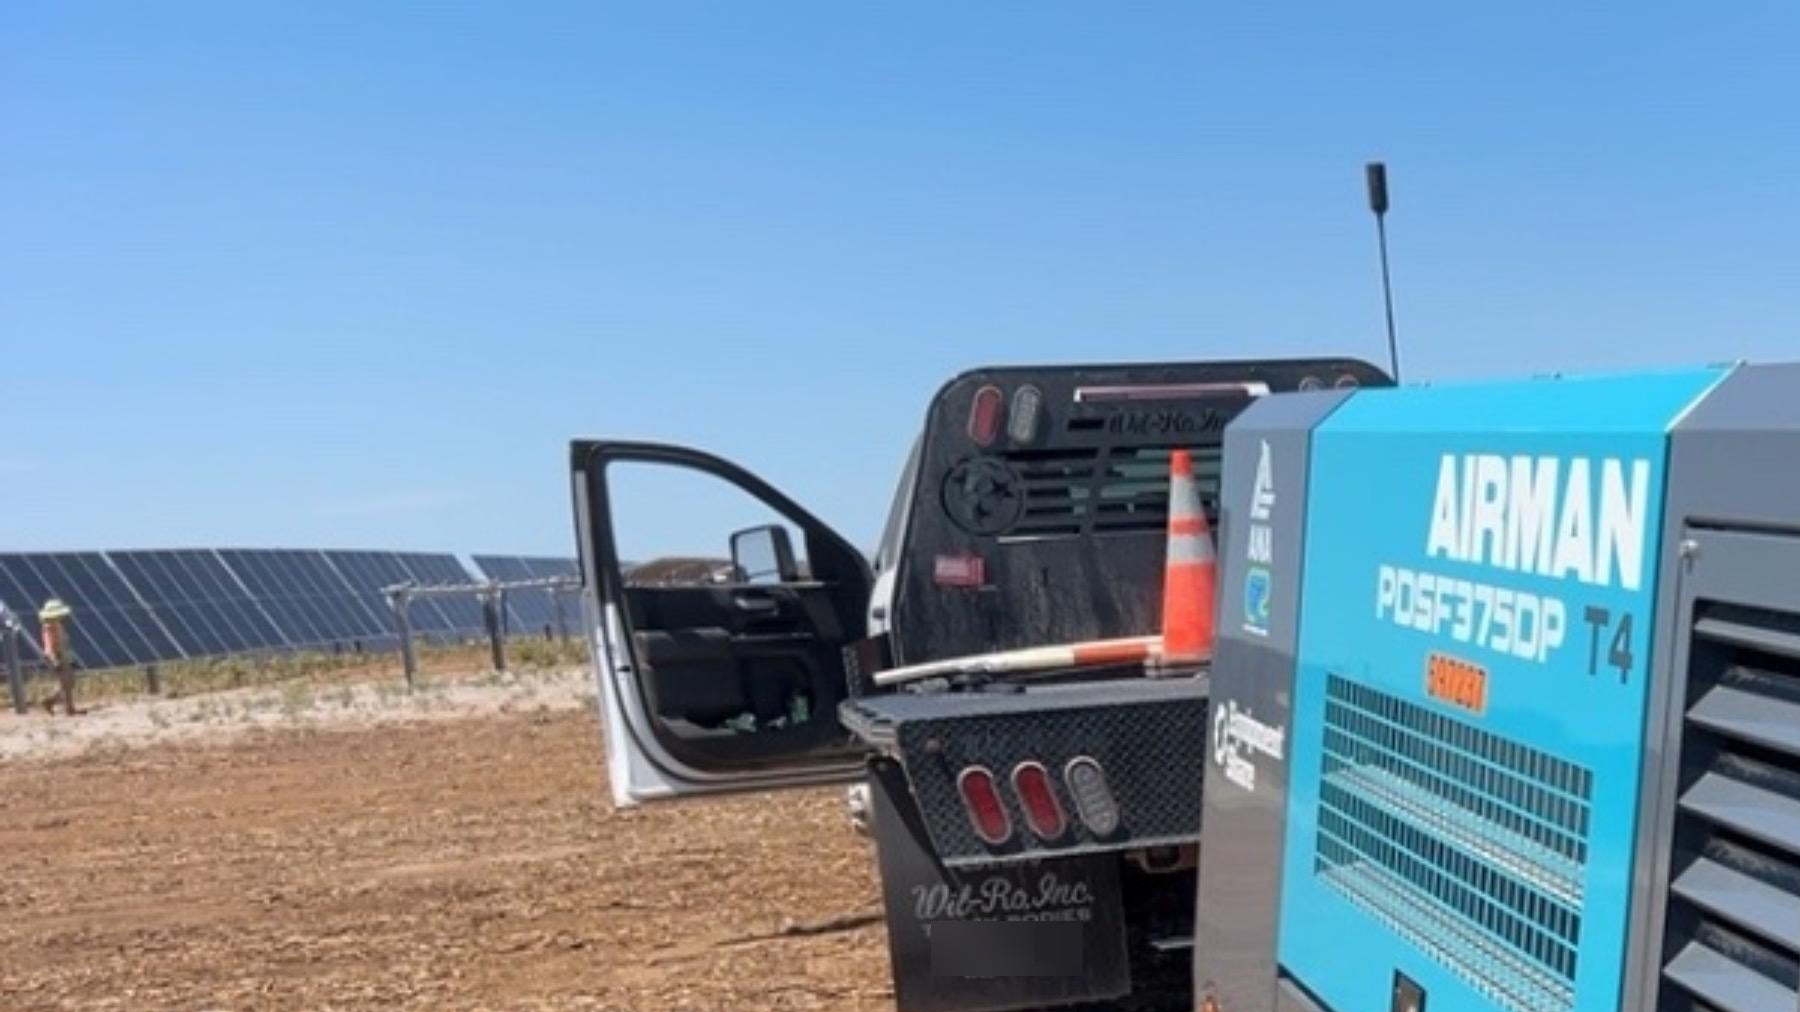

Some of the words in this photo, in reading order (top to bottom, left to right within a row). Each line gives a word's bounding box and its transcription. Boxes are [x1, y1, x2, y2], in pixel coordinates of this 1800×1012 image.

[1425, 454, 1650, 592] AIRMAN
[1375, 563, 1567, 664] PDSF375DP
[1583, 603, 1634, 686] T4
